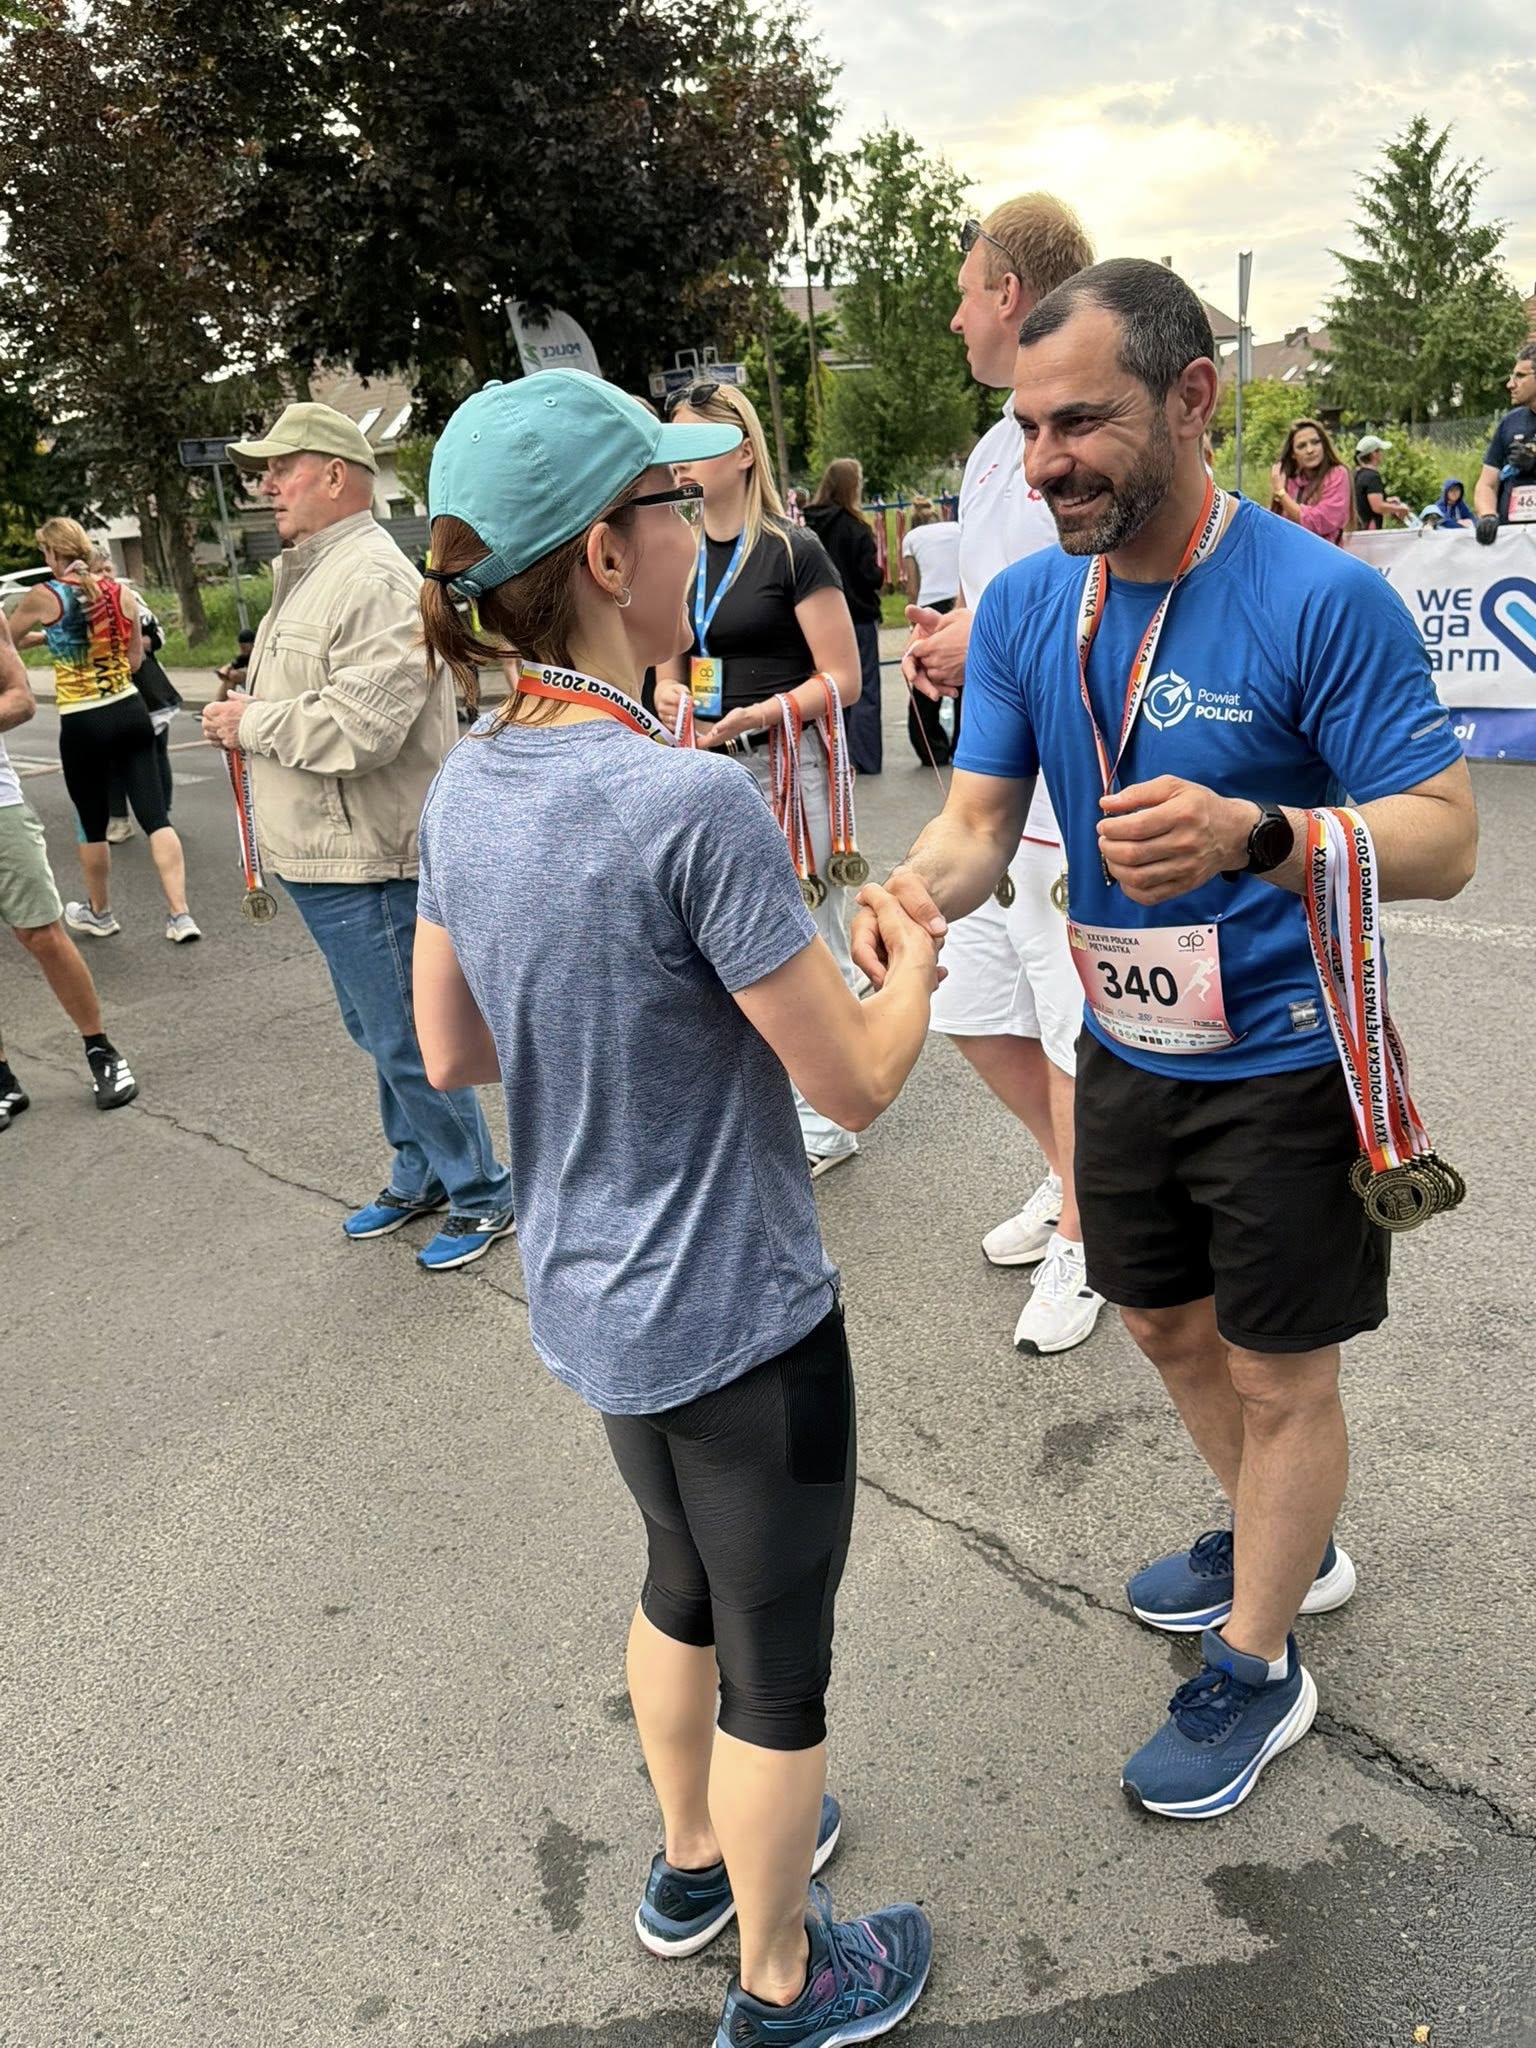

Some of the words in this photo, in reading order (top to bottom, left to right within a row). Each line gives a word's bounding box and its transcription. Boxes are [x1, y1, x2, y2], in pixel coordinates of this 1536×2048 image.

[1517, 496, 1536, 507] 46
[1192, 549, 1201, 559] 7
[1199, 494, 1221, 550] czerwca
[1416, 588, 1473, 612] we
[1423, 614, 1470, 645] ga
[542, 669, 586, 692] 2026
[1133, 680, 1142, 688] 7
[588, 681, 651, 730] czerwca
[1197, 688, 1241, 706] Powiat
[1195, 705, 1253, 723] POLICKI
[648, 729, 662, 741] 7
[1353, 827, 1371, 865] 2026
[1359, 867, 1374, 932] czerwca
[1087, 933, 1109, 943] XXXVII
[1111, 936, 1140, 946] POLICKA
[1089, 942, 1131, 954] PIĘTNASTKA
[1360, 934, 1374, 942] 7
[1097, 961, 1178, 1007] 340
[1362, 958, 1382, 1041] PIĘTNASTKA
[1366, 1047, 1385, 1103] POLICKA
[1371, 1105, 1389, 1145] XXXVII
